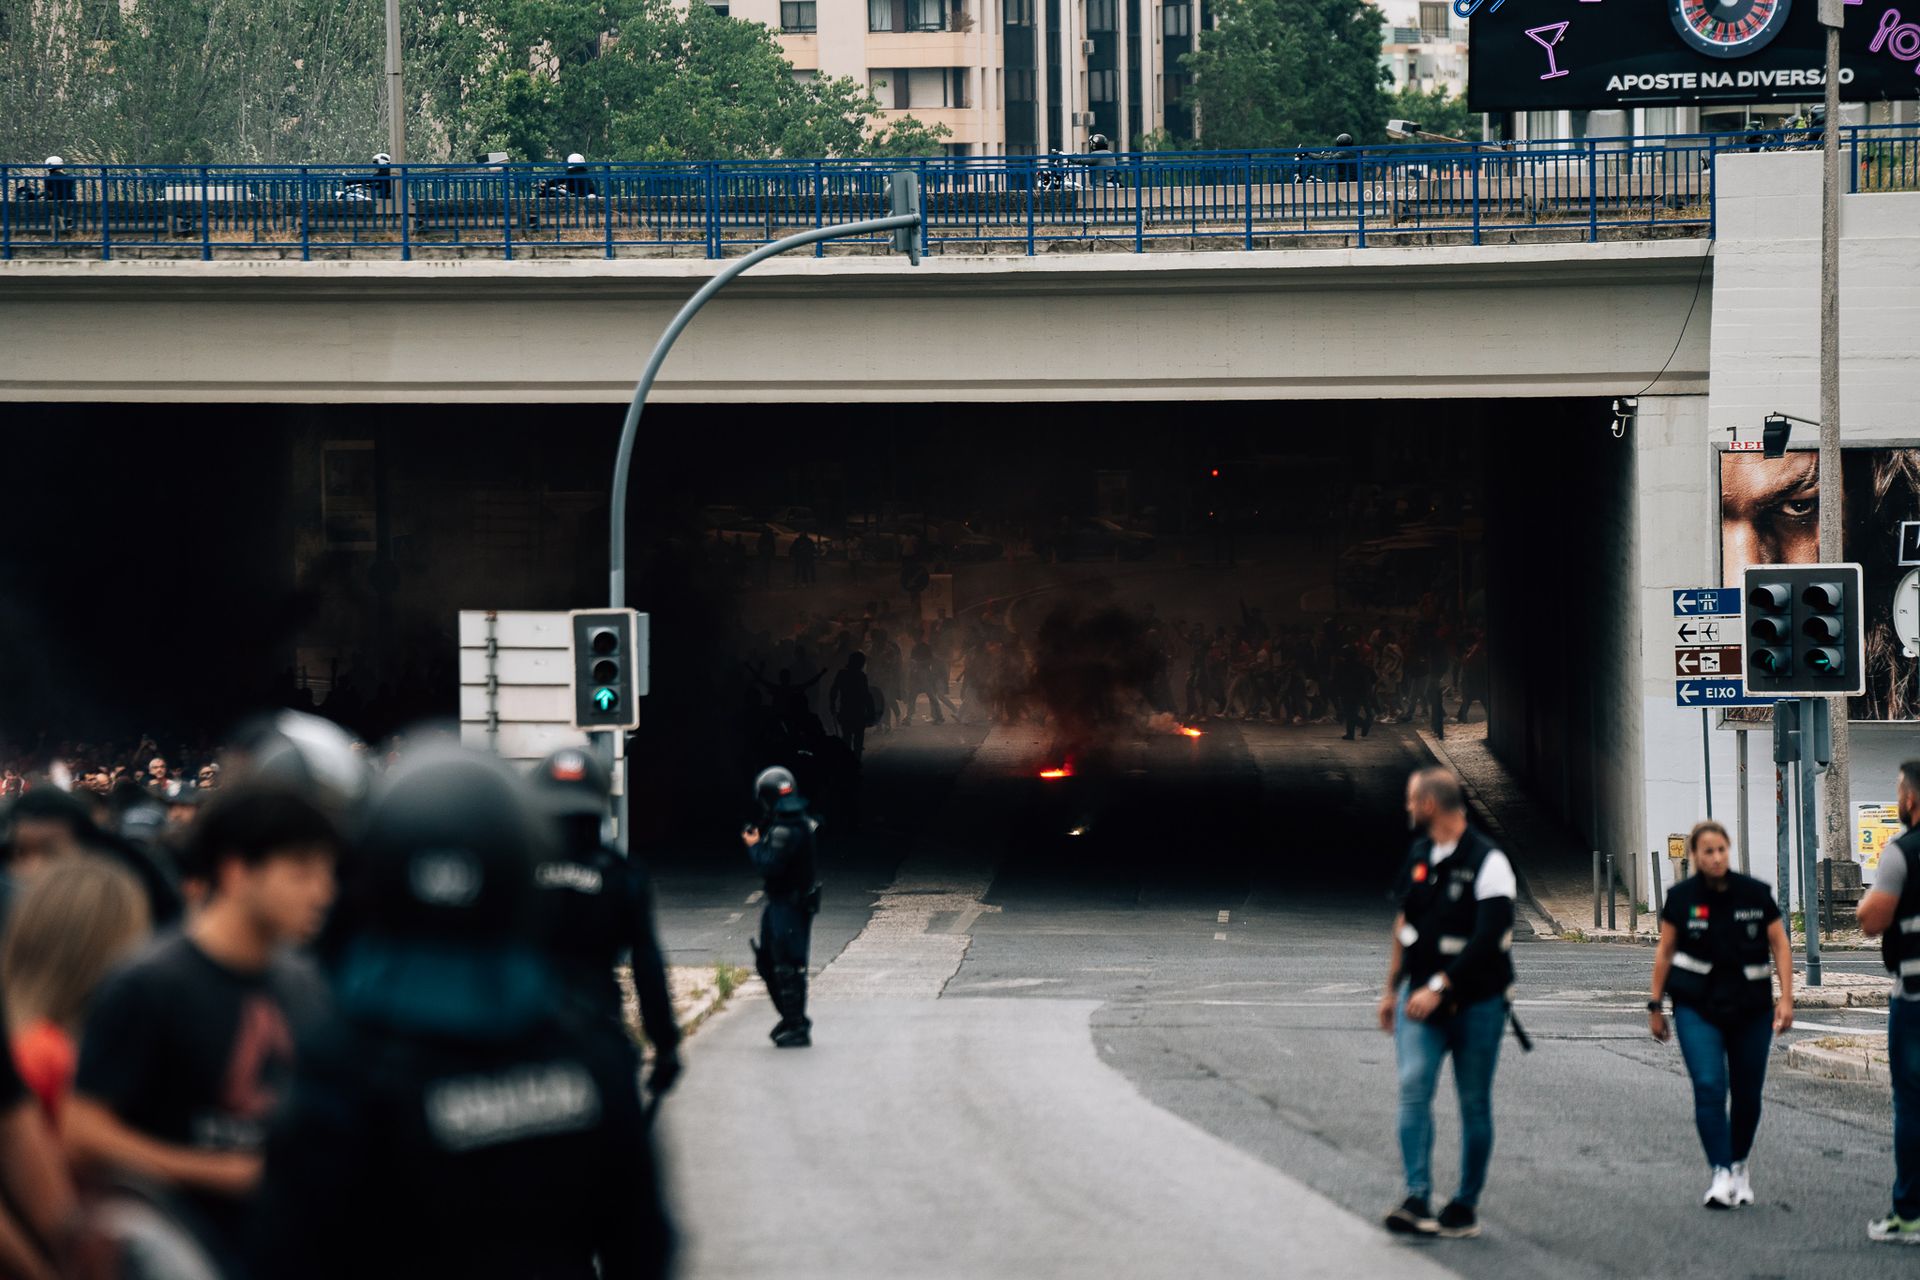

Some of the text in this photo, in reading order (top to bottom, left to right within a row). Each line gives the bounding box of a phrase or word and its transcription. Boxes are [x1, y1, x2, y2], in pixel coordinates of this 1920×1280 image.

[1606, 72, 1697, 91] APOSTE
[1701, 70, 1734, 88] NA
[1705, 687, 1736, 699] EIXO
[1863, 830, 1872, 843] 3
